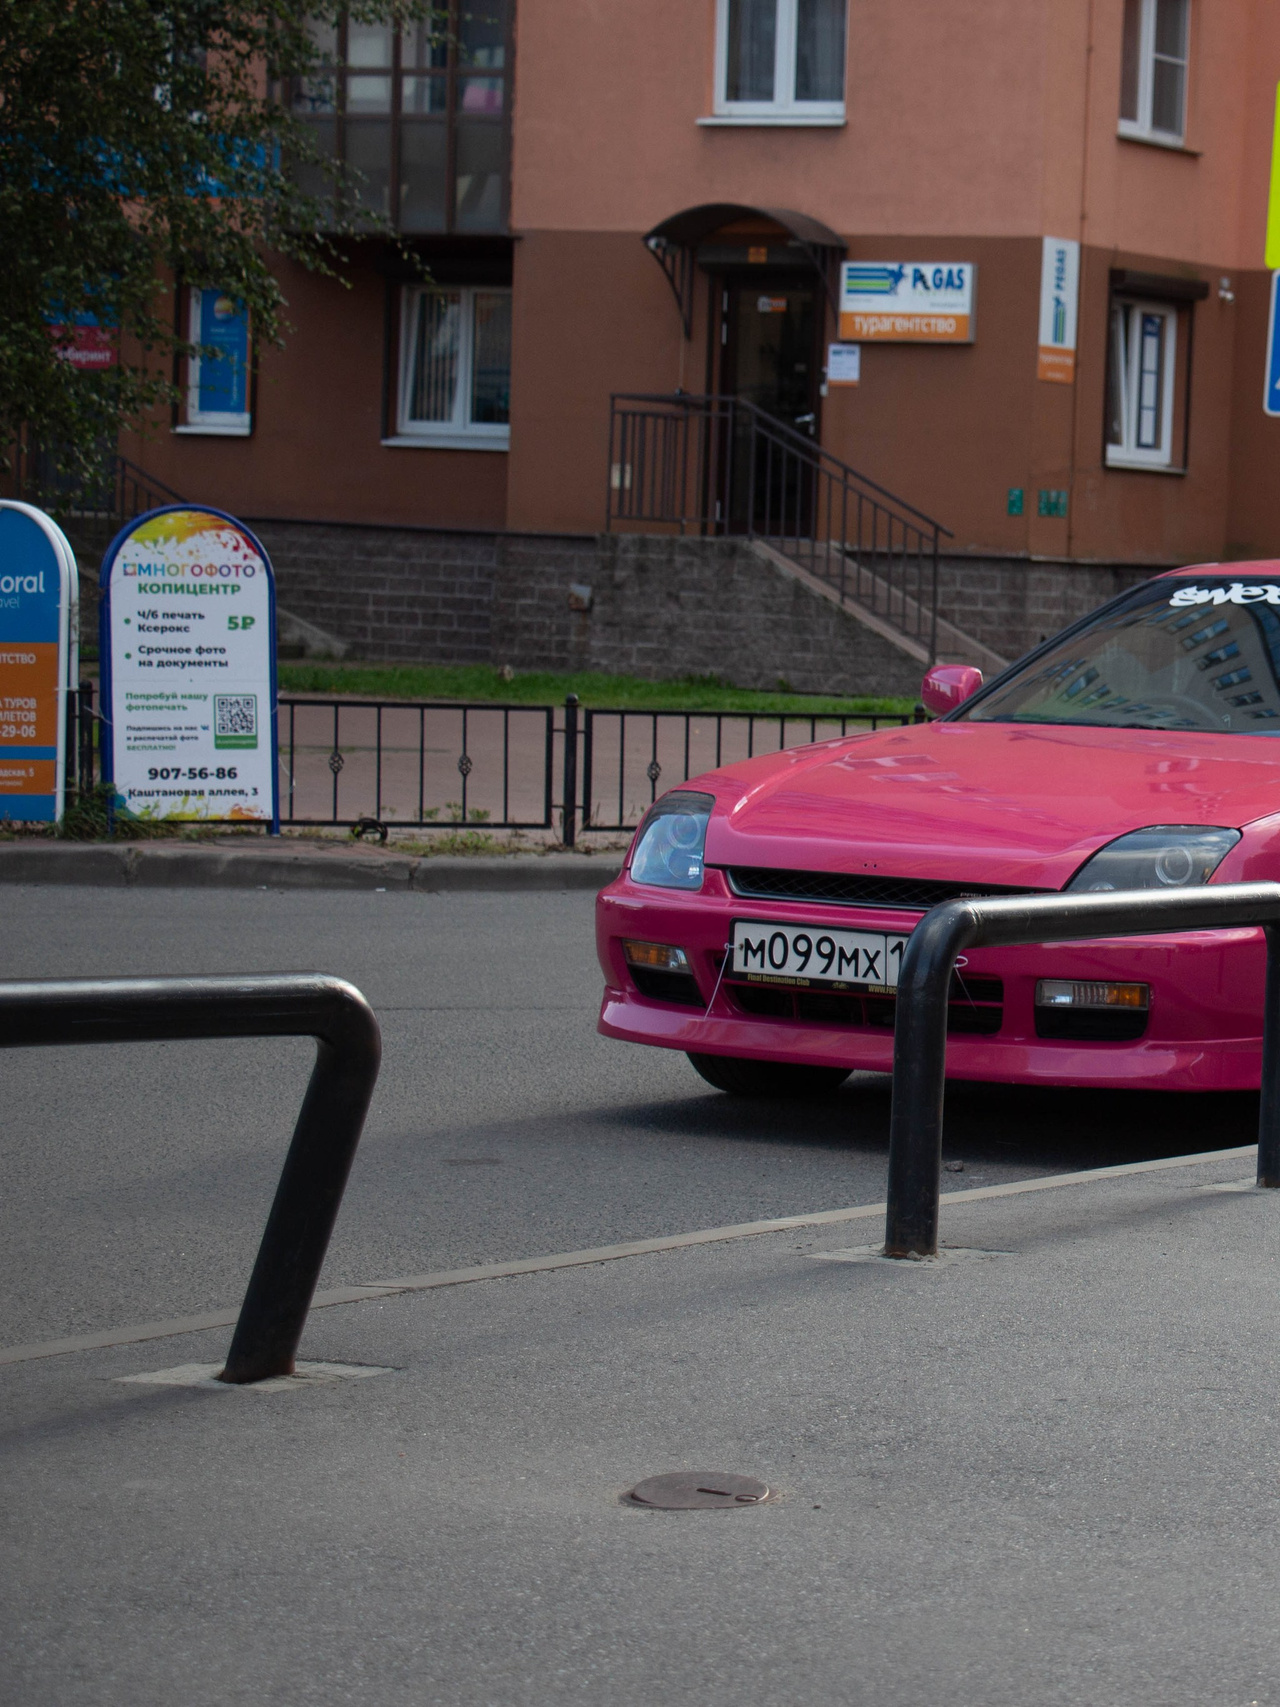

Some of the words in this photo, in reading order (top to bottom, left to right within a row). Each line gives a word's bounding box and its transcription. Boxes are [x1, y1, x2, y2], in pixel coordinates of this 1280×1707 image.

[853, 315, 957, 336] турагентство
[137, 563, 256, 578] МНОГОФОТО
[0, 570, 45, 593] oral
[137, 583, 241, 596] КОПИЦЕНТР
[137, 609, 158, 620] Ч/б
[162, 611, 205, 620] печать
[137, 623, 190, 634] Ксерокс
[138, 645, 192, 655] Срочное
[195, 646, 226, 656] фото
[0, 653, 36, 664] ТСТВО
[156, 660, 229, 669] документы
[126, 692, 178, 701] Попробуй
[181, 693, 208, 702] нашу
[4, 698, 36, 709] ТУРОВ
[126, 704, 188, 712] фотопечать
[147, 767, 237, 780] 907-56-86
[128, 788, 205, 797] Каштановая
[208, 788, 248, 797] аллея,
[251, 788, 258, 796] 3
[747, 973, 762, 982] Final
[762, 974, 796, 986] Destination
[796, 977, 810, 987] Club
